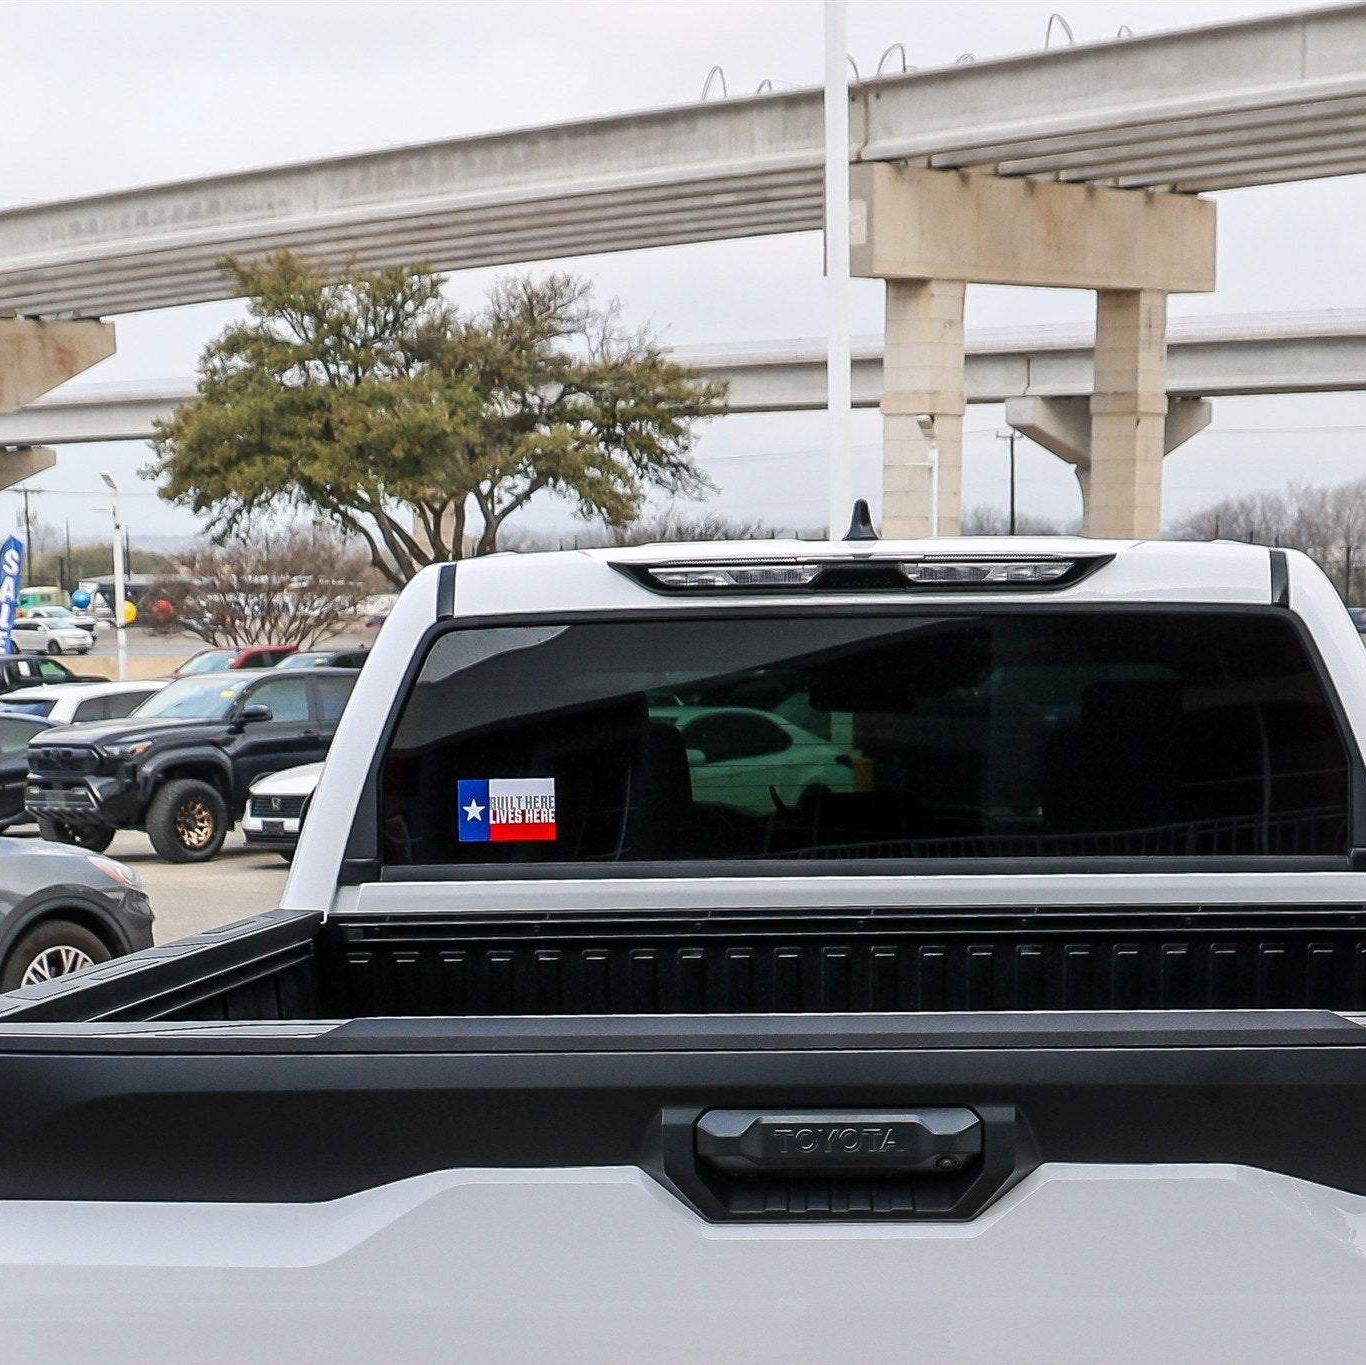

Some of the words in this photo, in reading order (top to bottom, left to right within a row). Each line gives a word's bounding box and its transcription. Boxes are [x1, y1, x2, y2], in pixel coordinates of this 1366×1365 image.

[490, 796, 522, 810] BUILT
[525, 795, 555, 810] HERE
[489, 809, 523, 824] LIVES
[525, 808, 556, 824] HERE
[773, 1127, 904, 1153] TOYOTA
